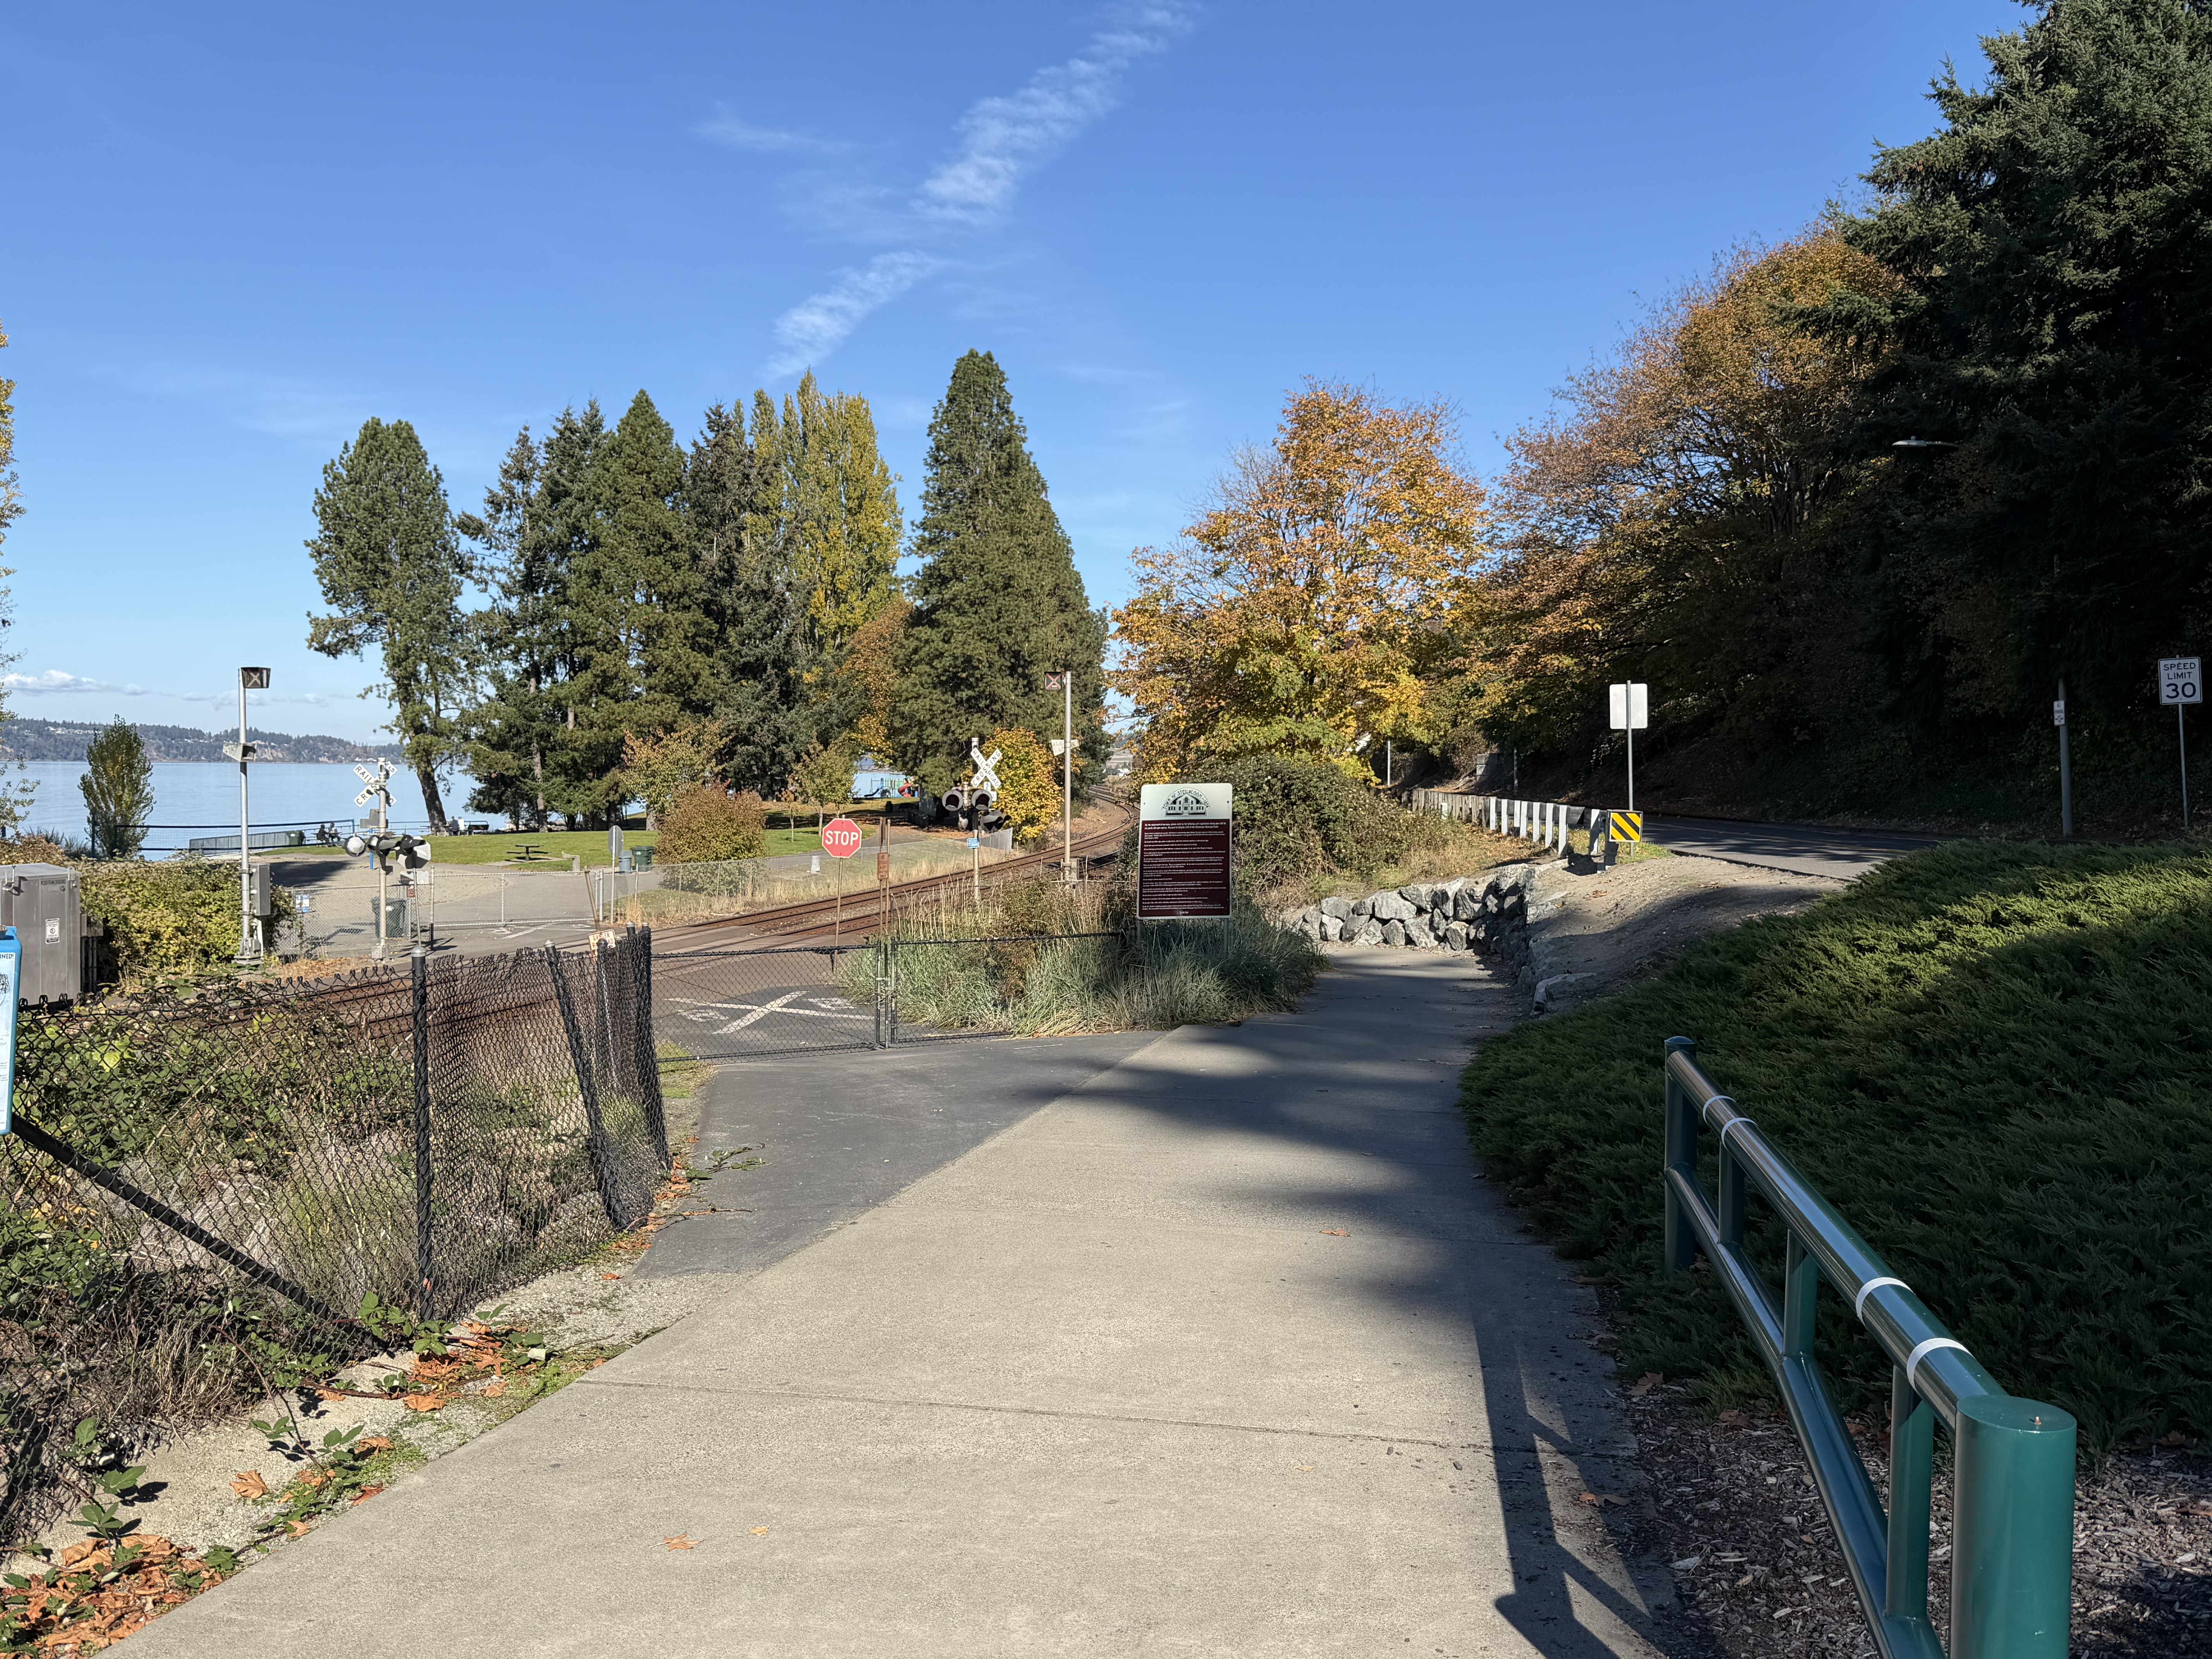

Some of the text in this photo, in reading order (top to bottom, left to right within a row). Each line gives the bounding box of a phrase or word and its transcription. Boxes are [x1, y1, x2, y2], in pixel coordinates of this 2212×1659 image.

[2164, 663, 2196, 671] SPEED
[2166, 682, 2196, 699] 30
[973, 751, 1000, 786] CROSSING
[1162, 798, 1171, 809] TOWN
[825, 830, 859, 846] STOP
